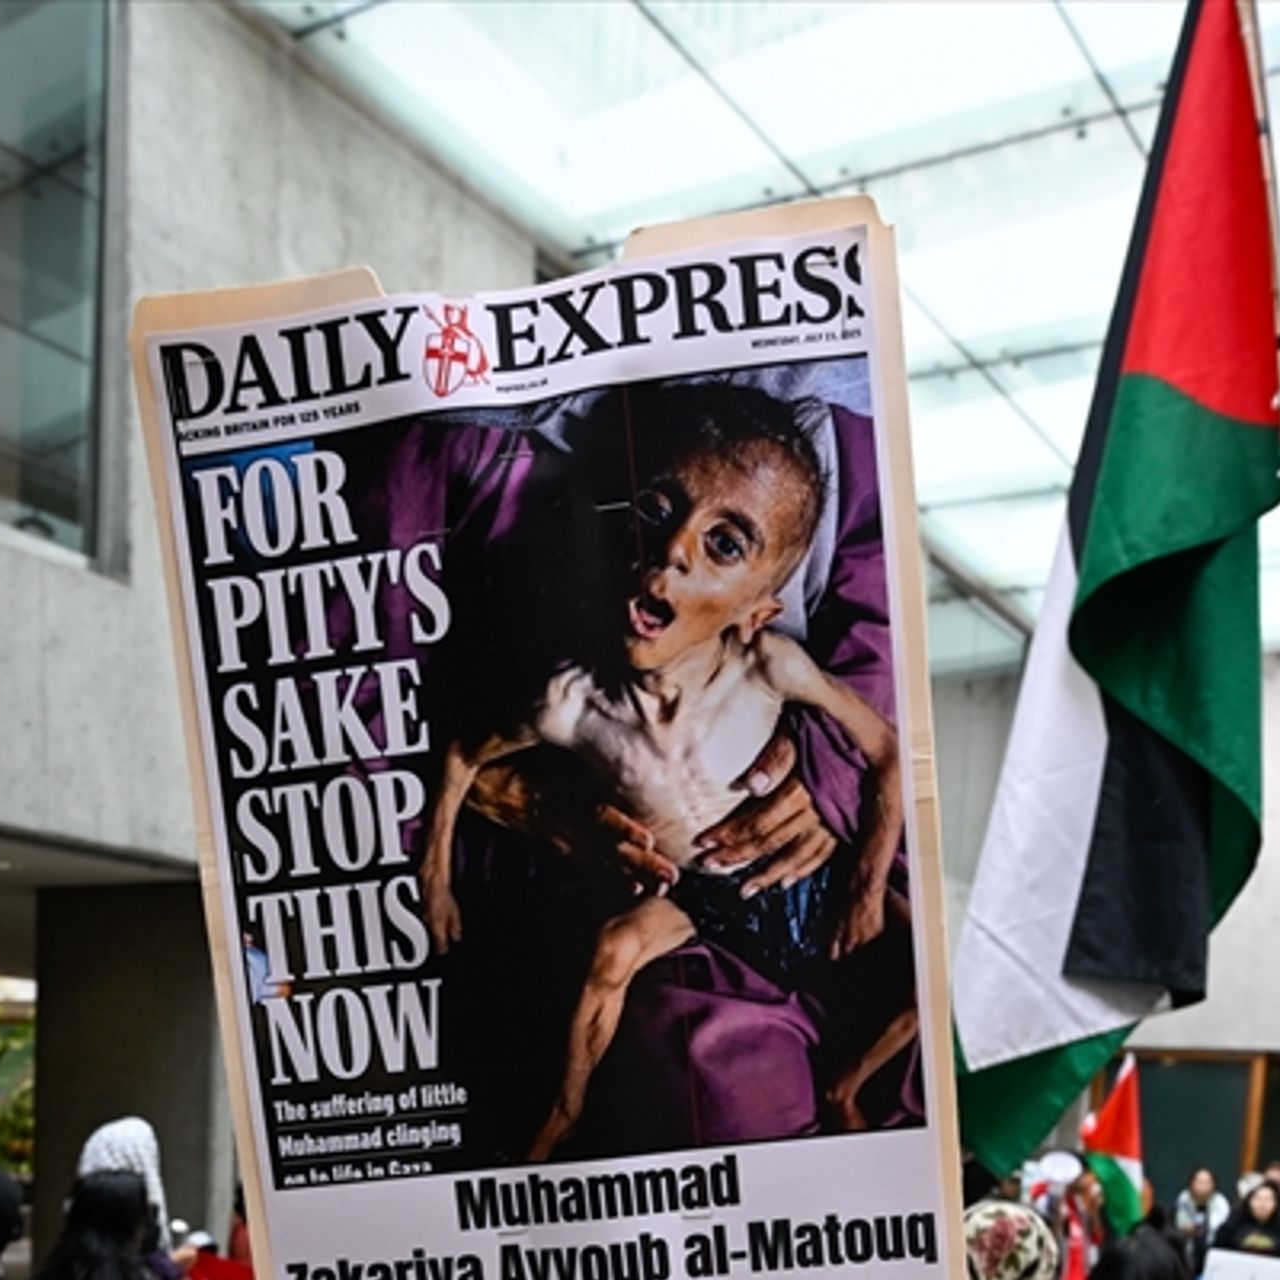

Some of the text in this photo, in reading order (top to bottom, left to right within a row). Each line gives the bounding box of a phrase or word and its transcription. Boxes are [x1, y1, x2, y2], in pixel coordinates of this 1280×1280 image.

[160, 306, 420, 420] DAILY
[223, 418, 270, 437] BRITAIN
[272, 413, 297, 428] FOR
[322, 401, 362, 420] YEARS
[192, 450, 358, 566] FOR
[206, 542, 452, 673] PITY'S
[223, 658, 430, 779] SAKE
[236, 769, 426, 884] STOP
[246, 875, 430, 984] THIS
[260, 978, 442, 1086] NOW
[273, 1083, 468, 1122] The suffering of little
[278, 1120, 462, 1158] Muhammad clinging
[454, 1153, 741, 1231] Muhammad
[683, 1212, 939, 1278] al-Matouq
